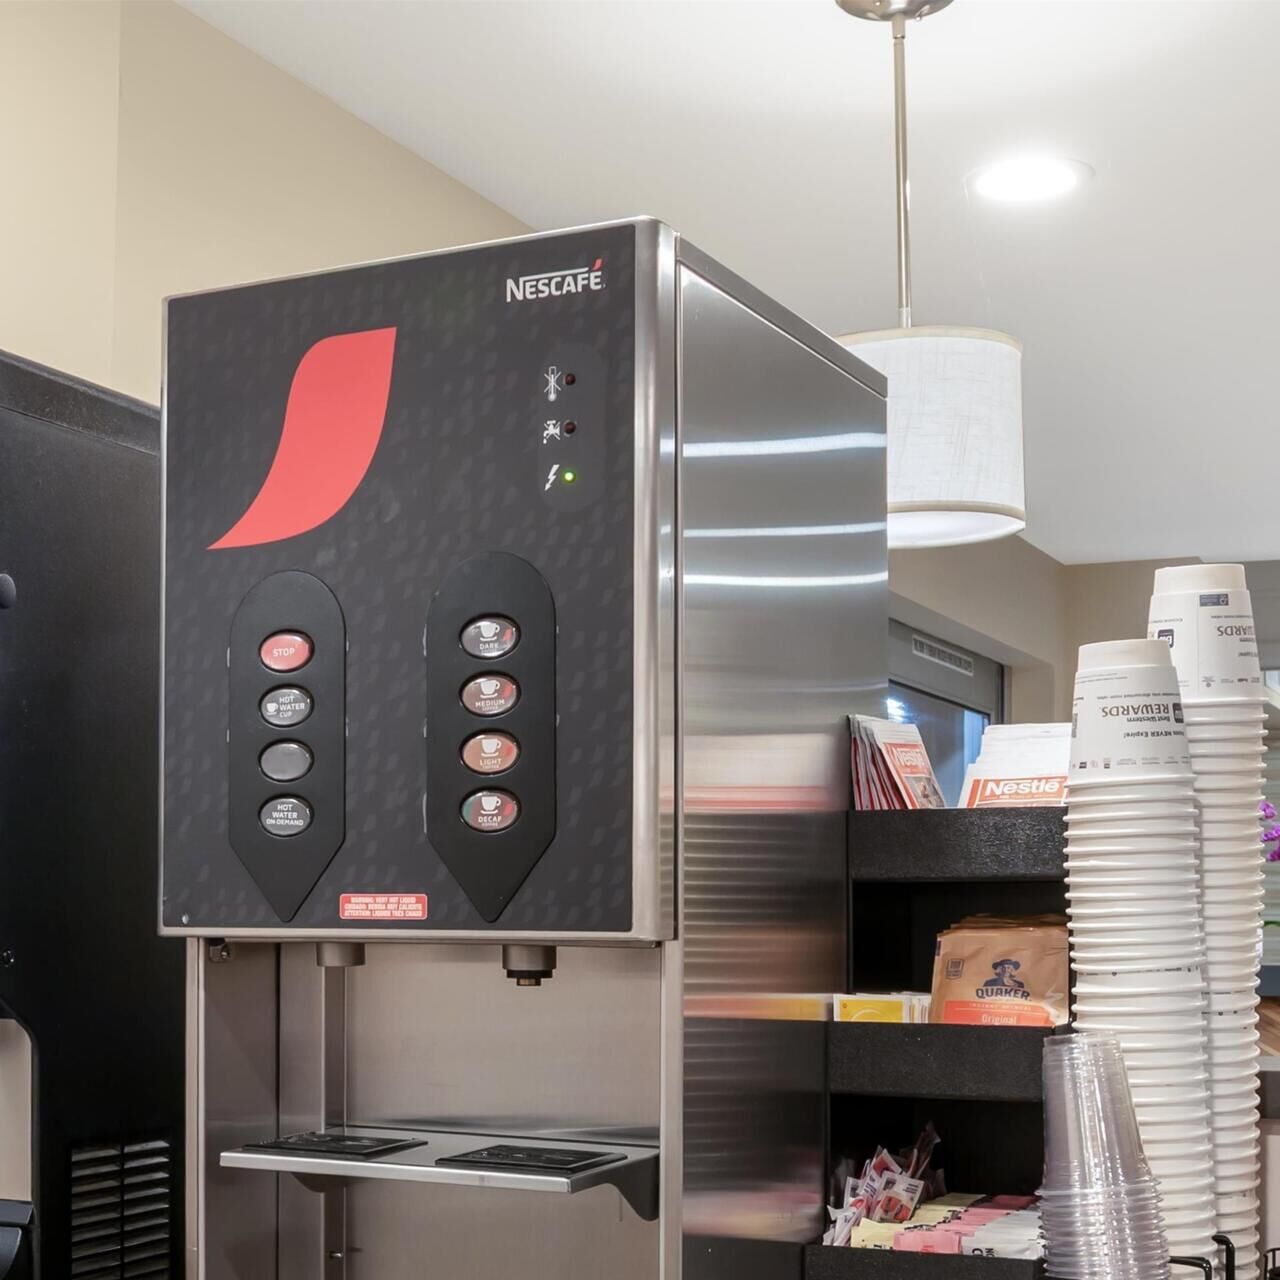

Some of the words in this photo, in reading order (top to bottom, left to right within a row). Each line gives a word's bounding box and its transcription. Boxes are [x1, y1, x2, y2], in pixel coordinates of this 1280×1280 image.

[505, 258, 602, 303] NESCAFÉ
[480, 642, 500, 650] DARK
[273, 647, 296, 657] STOP
[280, 695, 295, 703] HOT
[475, 698, 505, 708] MEDIUM
[280, 702, 305, 711] WATER
[1101, 703, 1170, 718] REWARDS
[480, 758, 502, 766] LIGHT
[272, 811, 298, 819] WATER
[478, 815, 502, 823] DECAF
[976, 987, 1030, 1001] QUAKER
